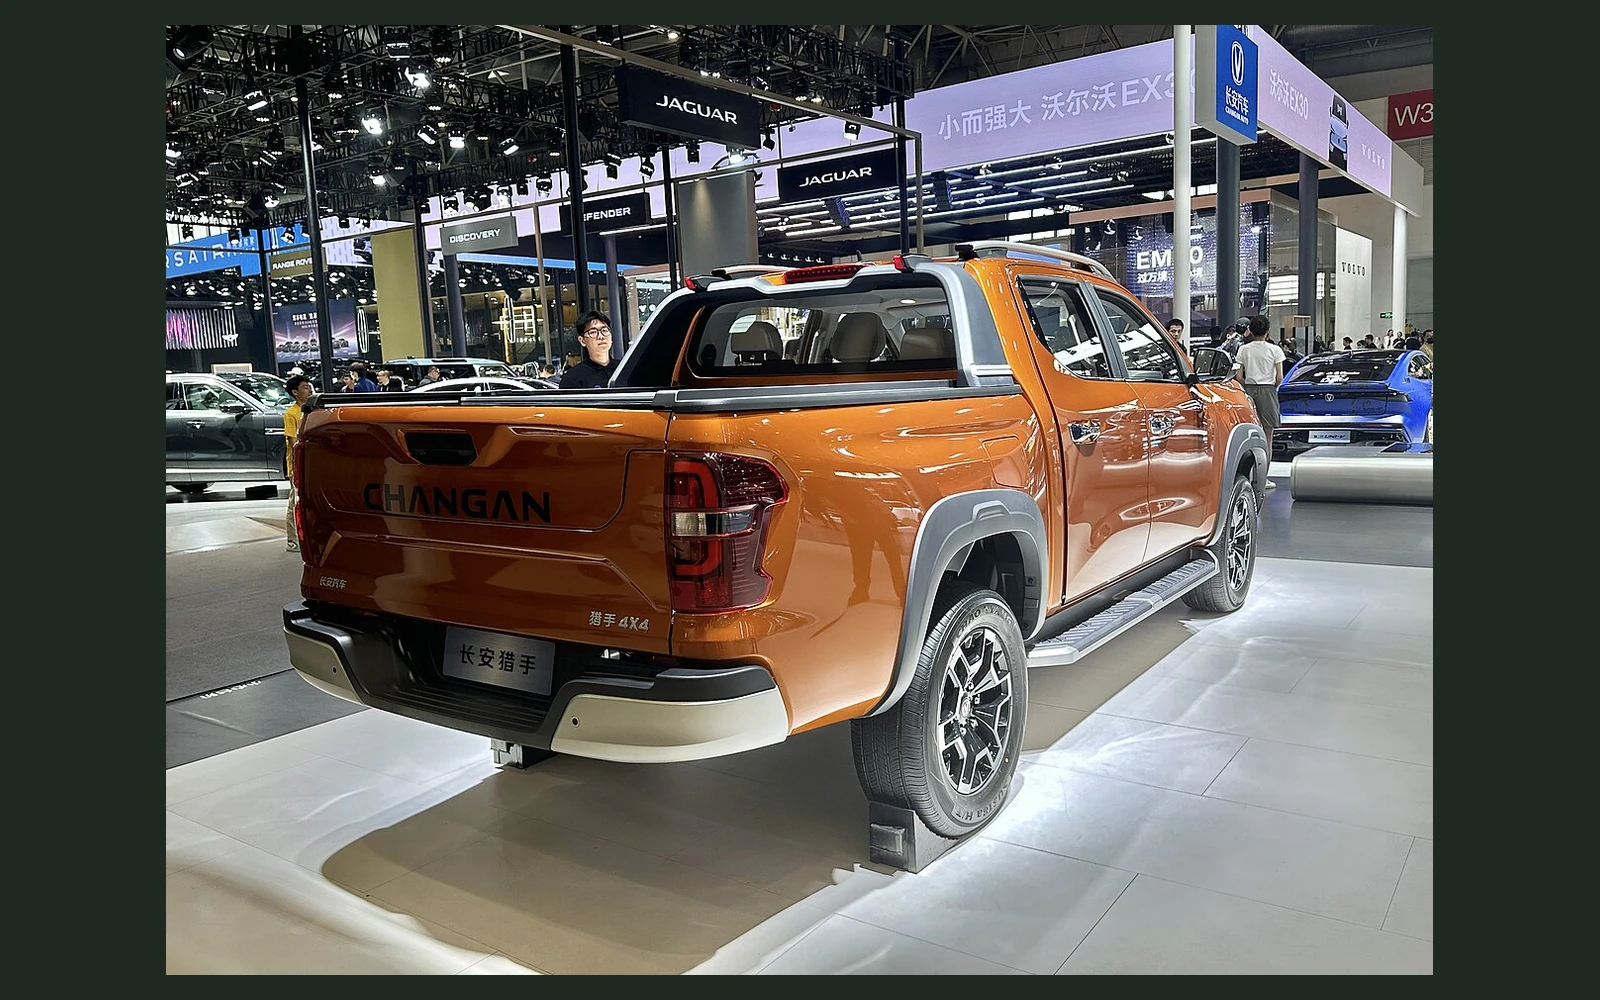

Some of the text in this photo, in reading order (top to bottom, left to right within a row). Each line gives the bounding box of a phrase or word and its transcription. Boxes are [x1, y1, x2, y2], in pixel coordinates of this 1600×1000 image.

[938, 70, 1196, 140] 小而强大 沃尔沃EX3
[1225, 85, 1249, 115] 长安汽车
[1269, 69, 1309, 120] 沃尔沃EX30
[656, 95, 738, 125] JAGUAR
[1394, 102, 1433, 127] W3
[1361, 143, 1386, 169] VOLVO
[798, 166, 873, 188] JAGUAR
[449, 228, 501, 244] DISCOVERY
[272, 257, 313, 270] RANGE ROVE
[1341, 261, 1366, 276] VOLVO
[364, 483, 551, 523] CHANGAN
[319, 576, 347, 590] 长安汽车
[589, 611, 616, 627] 猎手
[459, 643, 537, 675] 长安猎手
